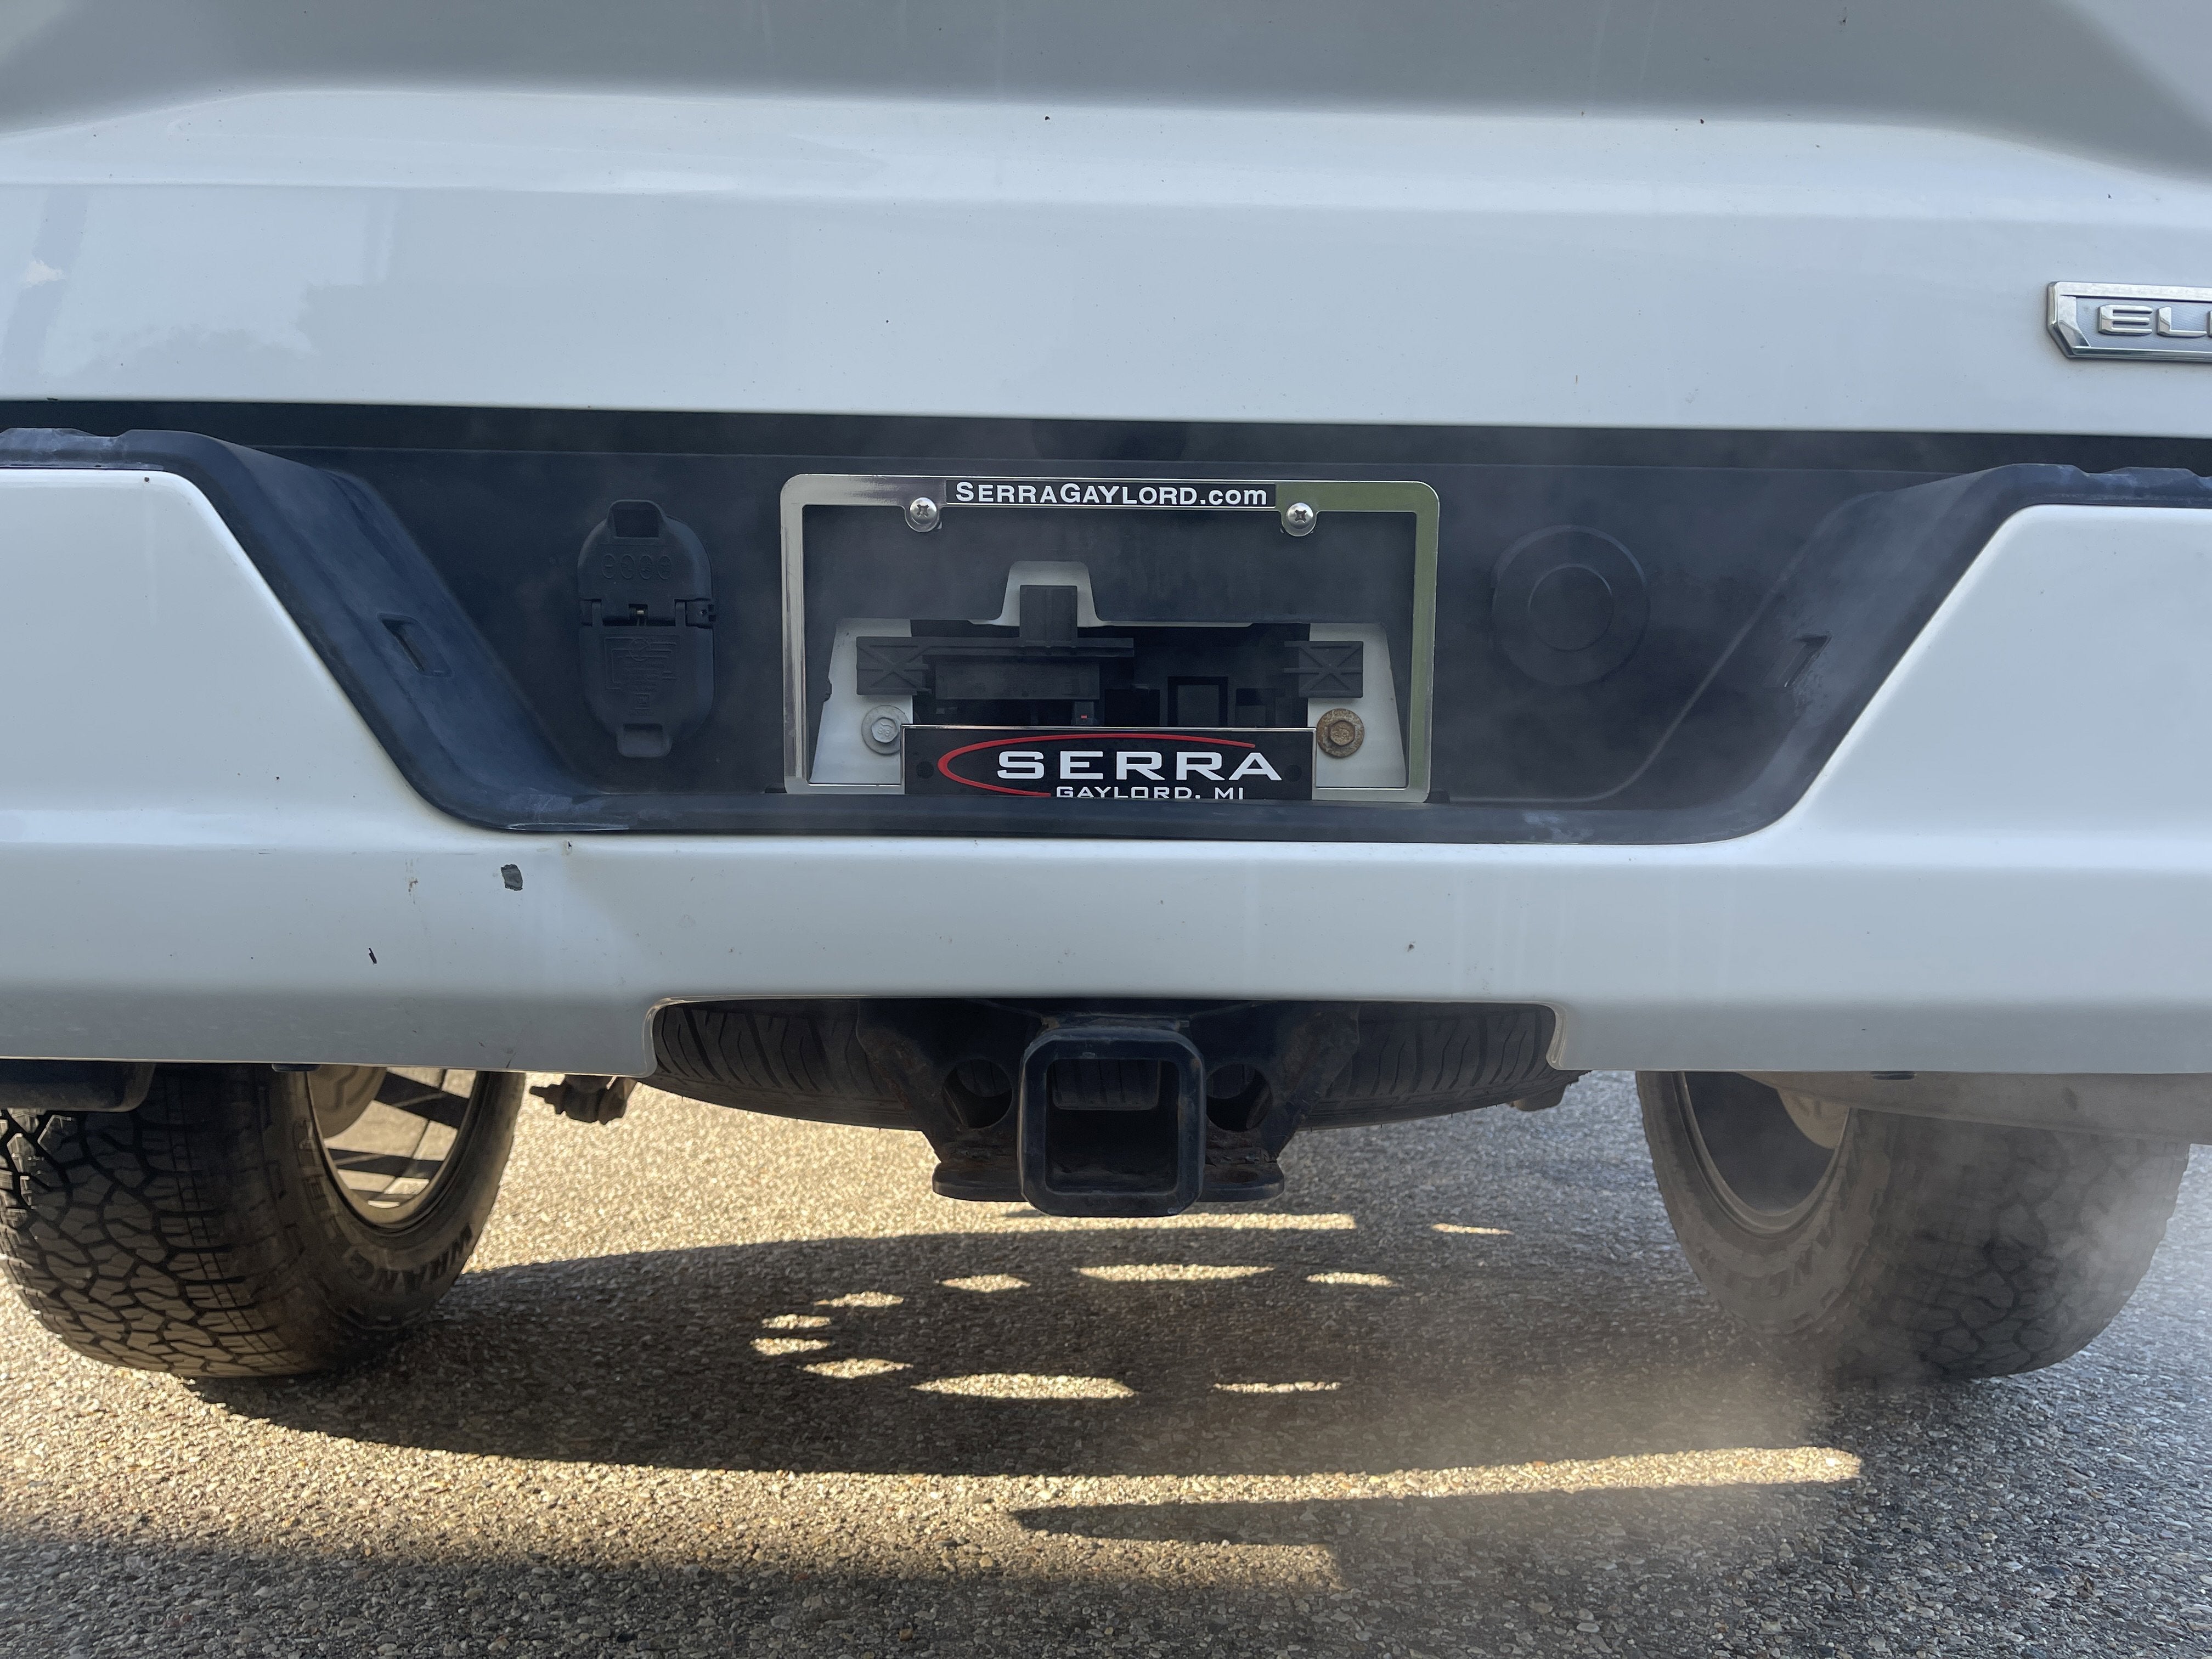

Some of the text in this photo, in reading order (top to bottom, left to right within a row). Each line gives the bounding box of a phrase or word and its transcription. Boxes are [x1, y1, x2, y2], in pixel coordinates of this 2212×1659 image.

[2098, 304, 2212, 338] EL
[955, 481, 1267, 505] SERRAGAYLORD.com
[997, 751, 1282, 781] SERRA
[1215, 787, 1243, 800] MI
